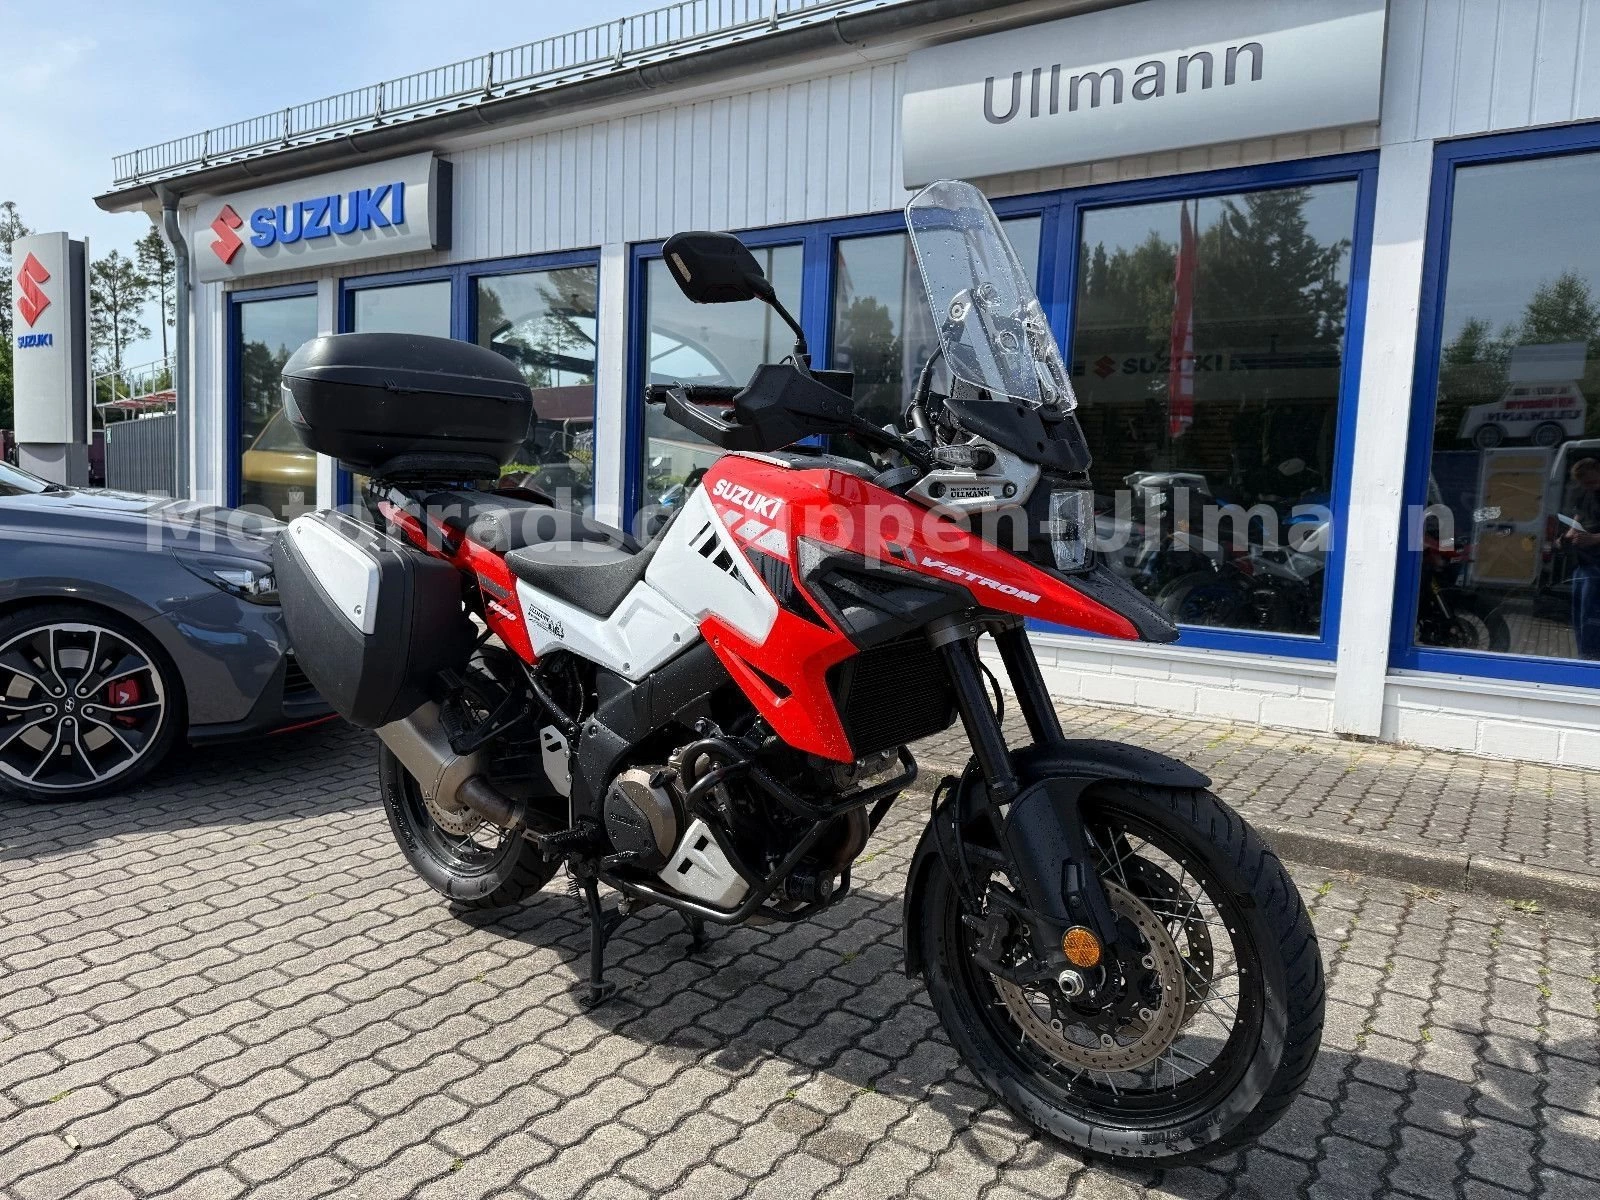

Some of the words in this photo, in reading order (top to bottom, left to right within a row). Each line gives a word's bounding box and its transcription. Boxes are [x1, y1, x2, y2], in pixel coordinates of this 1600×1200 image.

[983, 41, 1264, 125] Ullmann
[250, 181, 405, 249] SUZUKI
[17, 332, 53, 349] SUZUKI
[712, 478, 784, 520] SUZUKI
[950, 490, 990, 498] ULLMANN
[921, 556, 1042, 604] V-STROM
[487, 599, 518, 621] 1050
